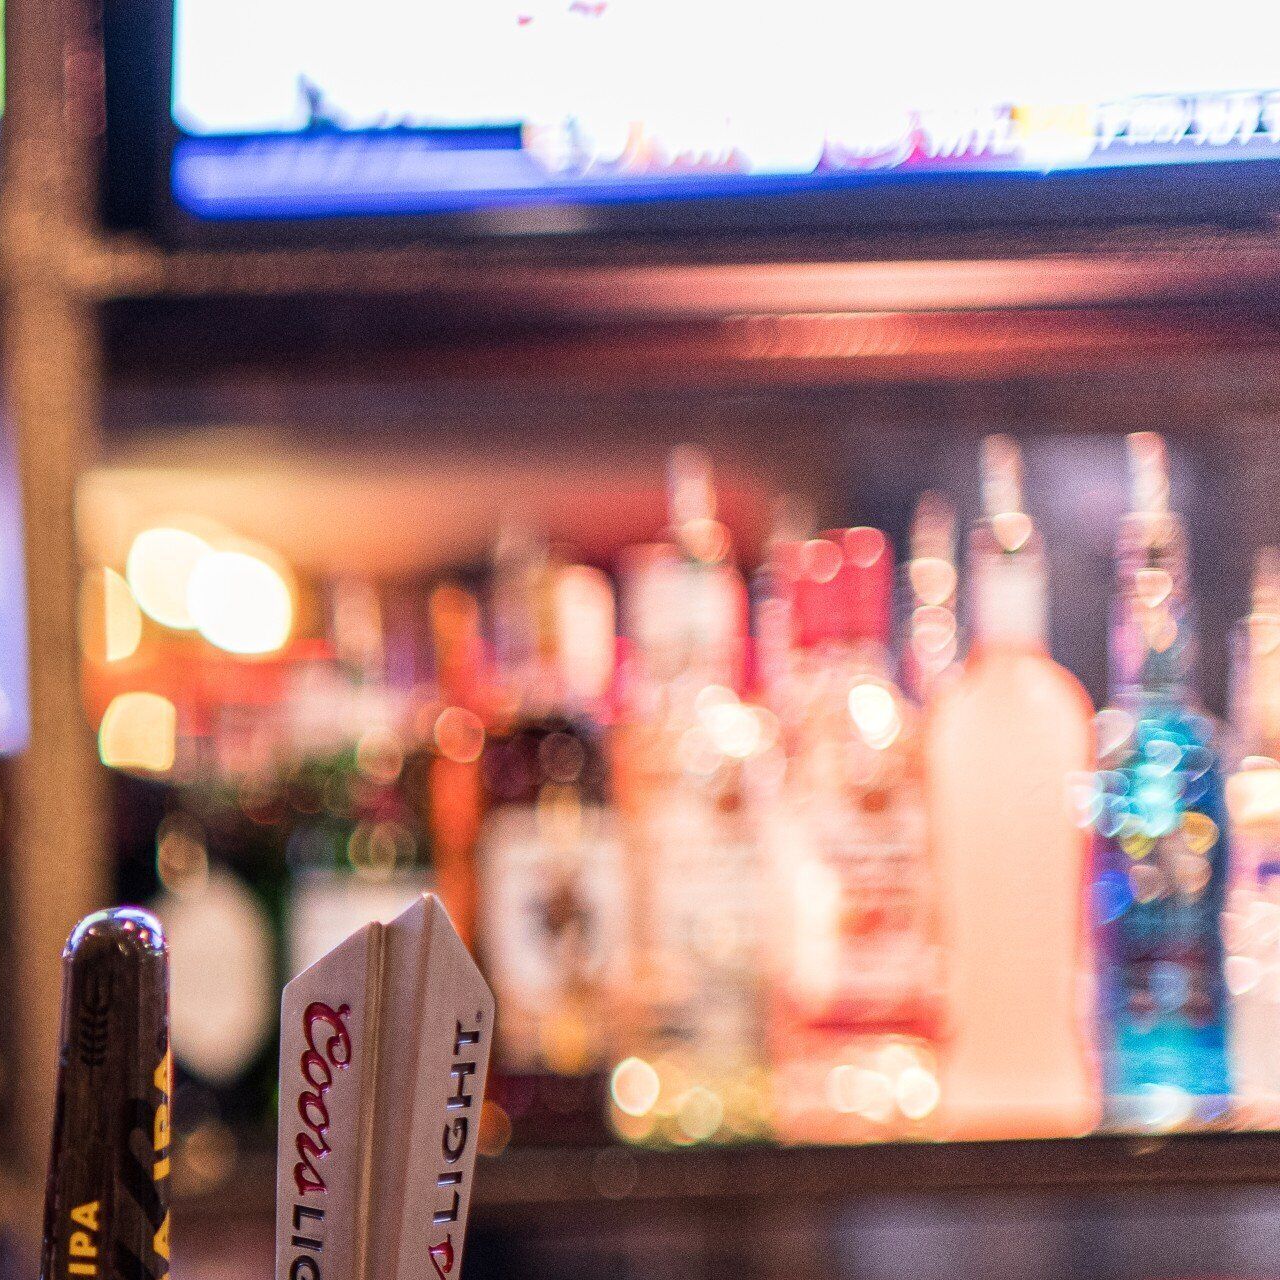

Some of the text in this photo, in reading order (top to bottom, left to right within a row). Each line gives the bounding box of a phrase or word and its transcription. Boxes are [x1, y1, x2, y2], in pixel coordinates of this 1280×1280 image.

[295, 1001, 352, 1197] Coors
[433, 1021, 481, 1226] LIGHT
[67, 1201, 100, 1276] IPA
